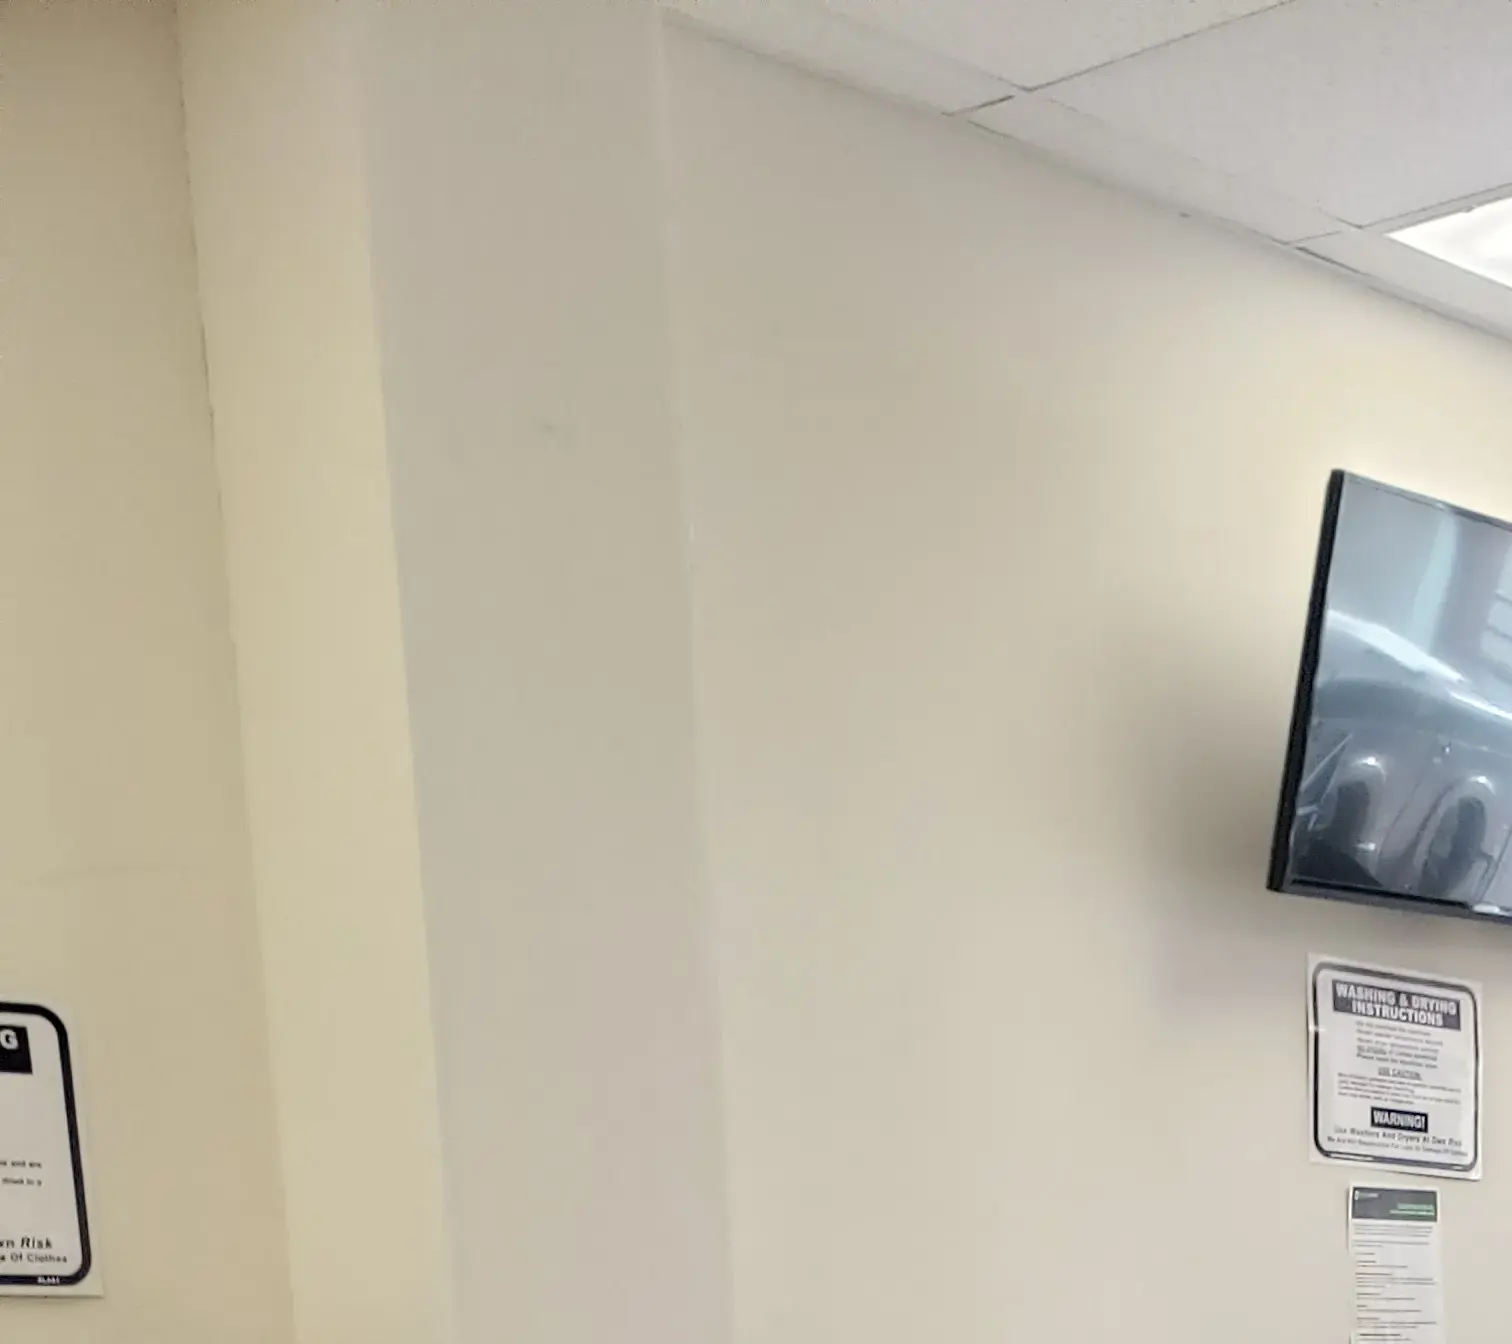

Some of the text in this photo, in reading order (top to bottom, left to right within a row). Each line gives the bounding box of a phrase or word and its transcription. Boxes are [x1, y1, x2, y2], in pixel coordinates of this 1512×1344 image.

[1335, 982, 1396, 1005] WASHING
[1412, 994, 1457, 1016] DRYING
[1352, 1001, 1443, 1026] INSTRUCTIONS
[1373, 1110, 1426, 1129] WARNING!
[21, 1236, 52, 1250] Risk
